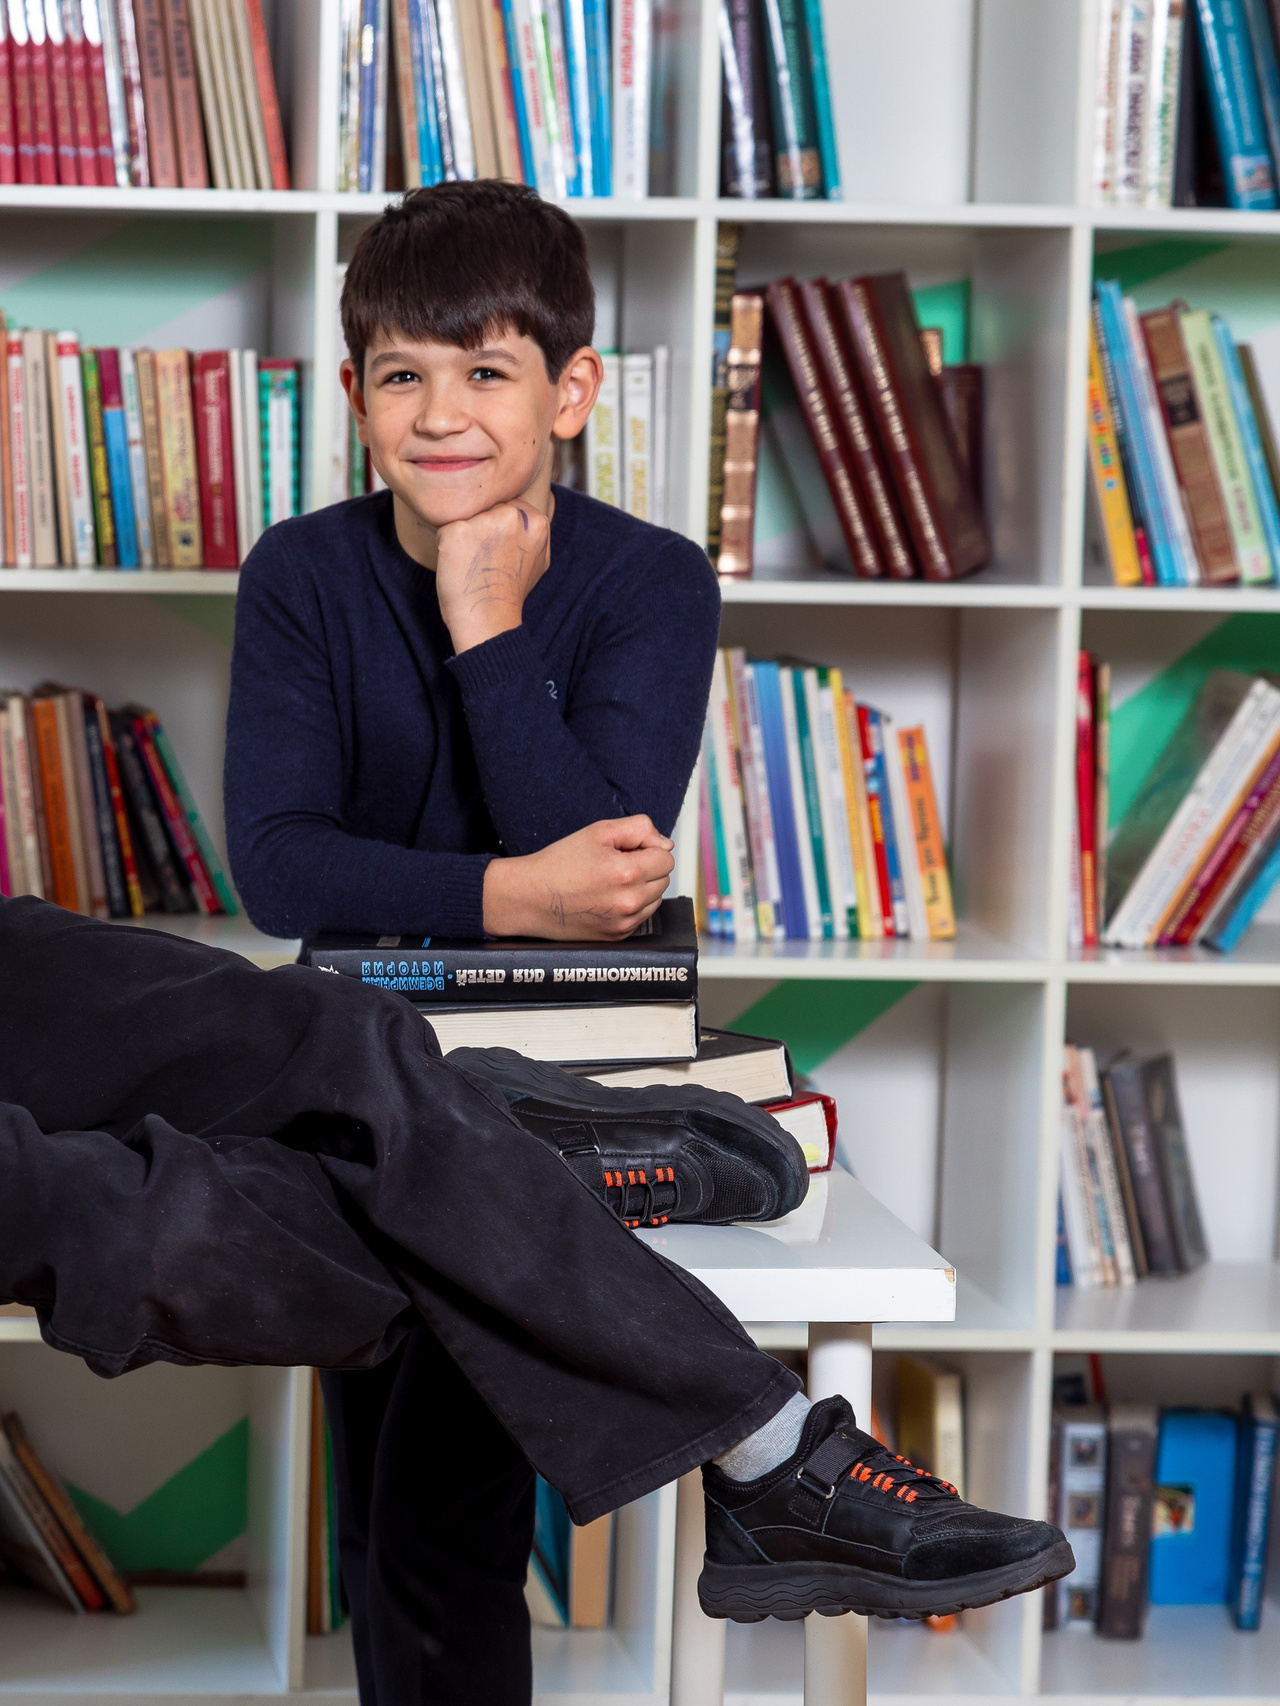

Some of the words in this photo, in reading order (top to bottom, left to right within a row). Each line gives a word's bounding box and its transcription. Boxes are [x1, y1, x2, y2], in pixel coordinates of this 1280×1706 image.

[361, 960, 444, 976] ИСТОРИЯ
[512, 968, 545, 983] ДЛЯ
[553, 967, 688, 983] ЭНЦИКЛОПЕДИЯ
[455, 969, 506, 986] ДЕТЕЙ
